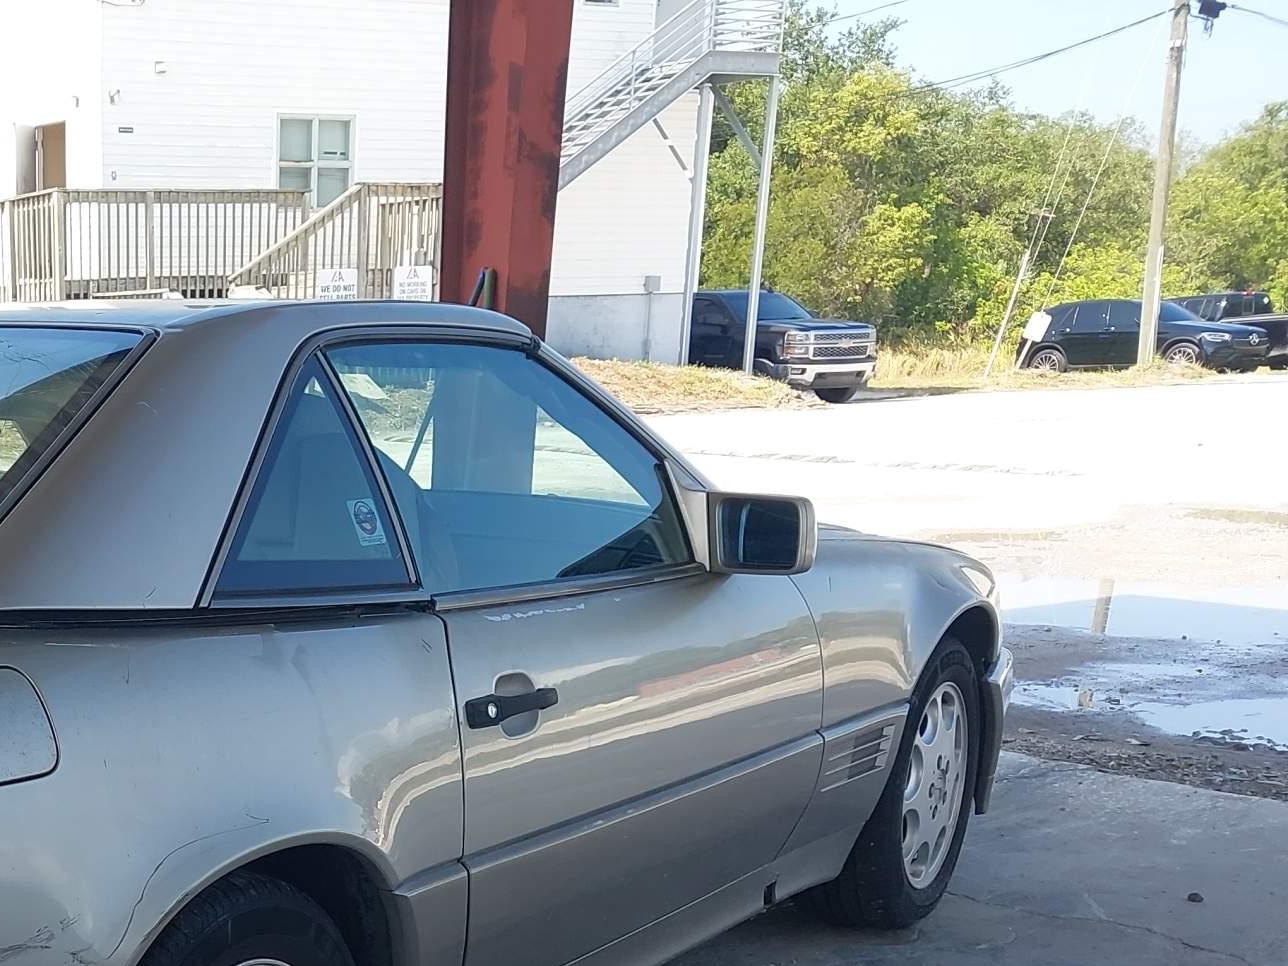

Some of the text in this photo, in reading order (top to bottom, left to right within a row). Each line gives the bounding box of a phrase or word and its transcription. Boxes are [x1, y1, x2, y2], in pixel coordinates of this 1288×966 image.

[320, 284, 355, 293] WE DO NOT
